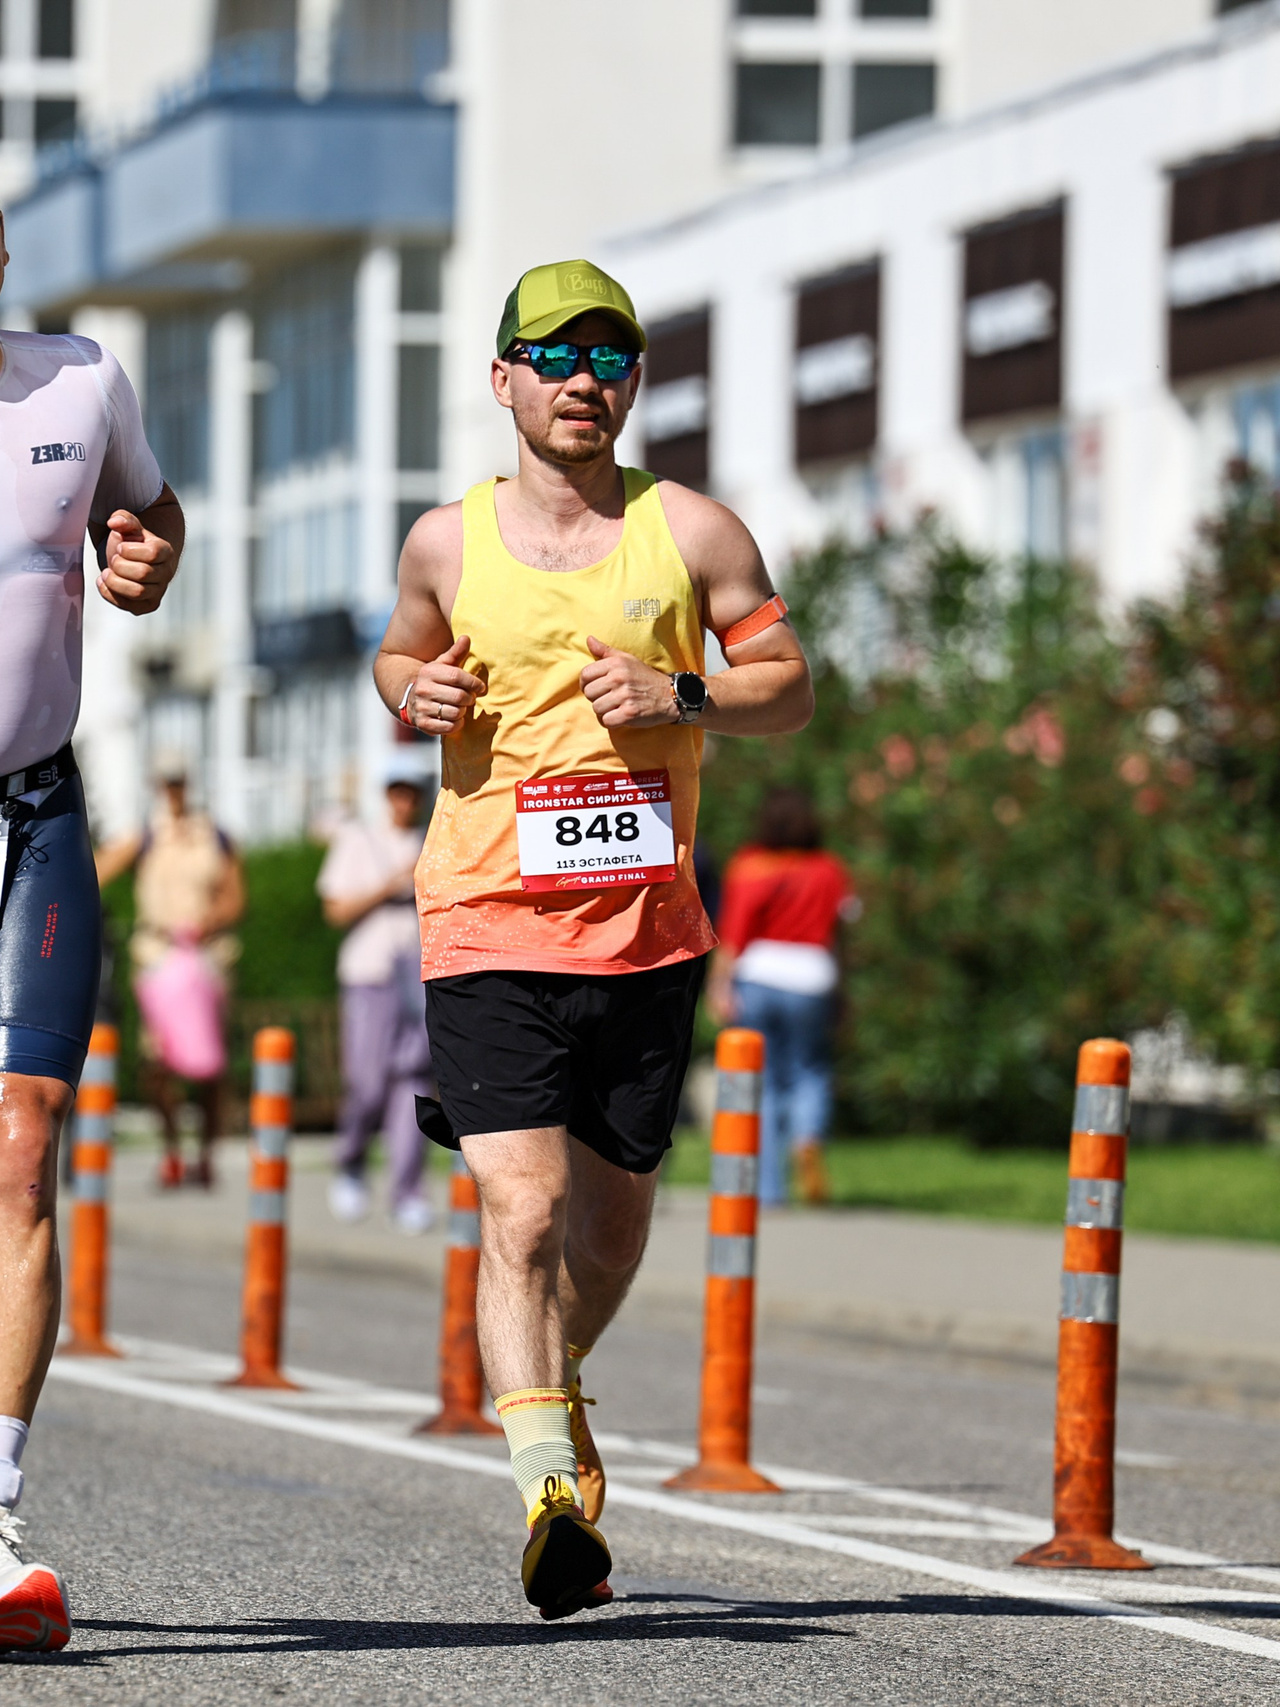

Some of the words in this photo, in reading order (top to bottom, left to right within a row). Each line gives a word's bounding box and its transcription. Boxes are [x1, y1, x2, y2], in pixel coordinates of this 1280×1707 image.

[569, 273, 604, 294] Buff
[38, 765, 59, 784] Si
[523, 796, 584, 810] IRONSTAR
[587, 792, 634, 805] СИРИУС
[636, 790, 665, 801] 2026
[555, 811, 640, 846] 848
[557, 859, 576, 869] 113
[579, 854, 643, 867] ЭСТАФЕТА
[581, 875, 616, 884] GRAND
[618, 872, 647, 881] FINAL
